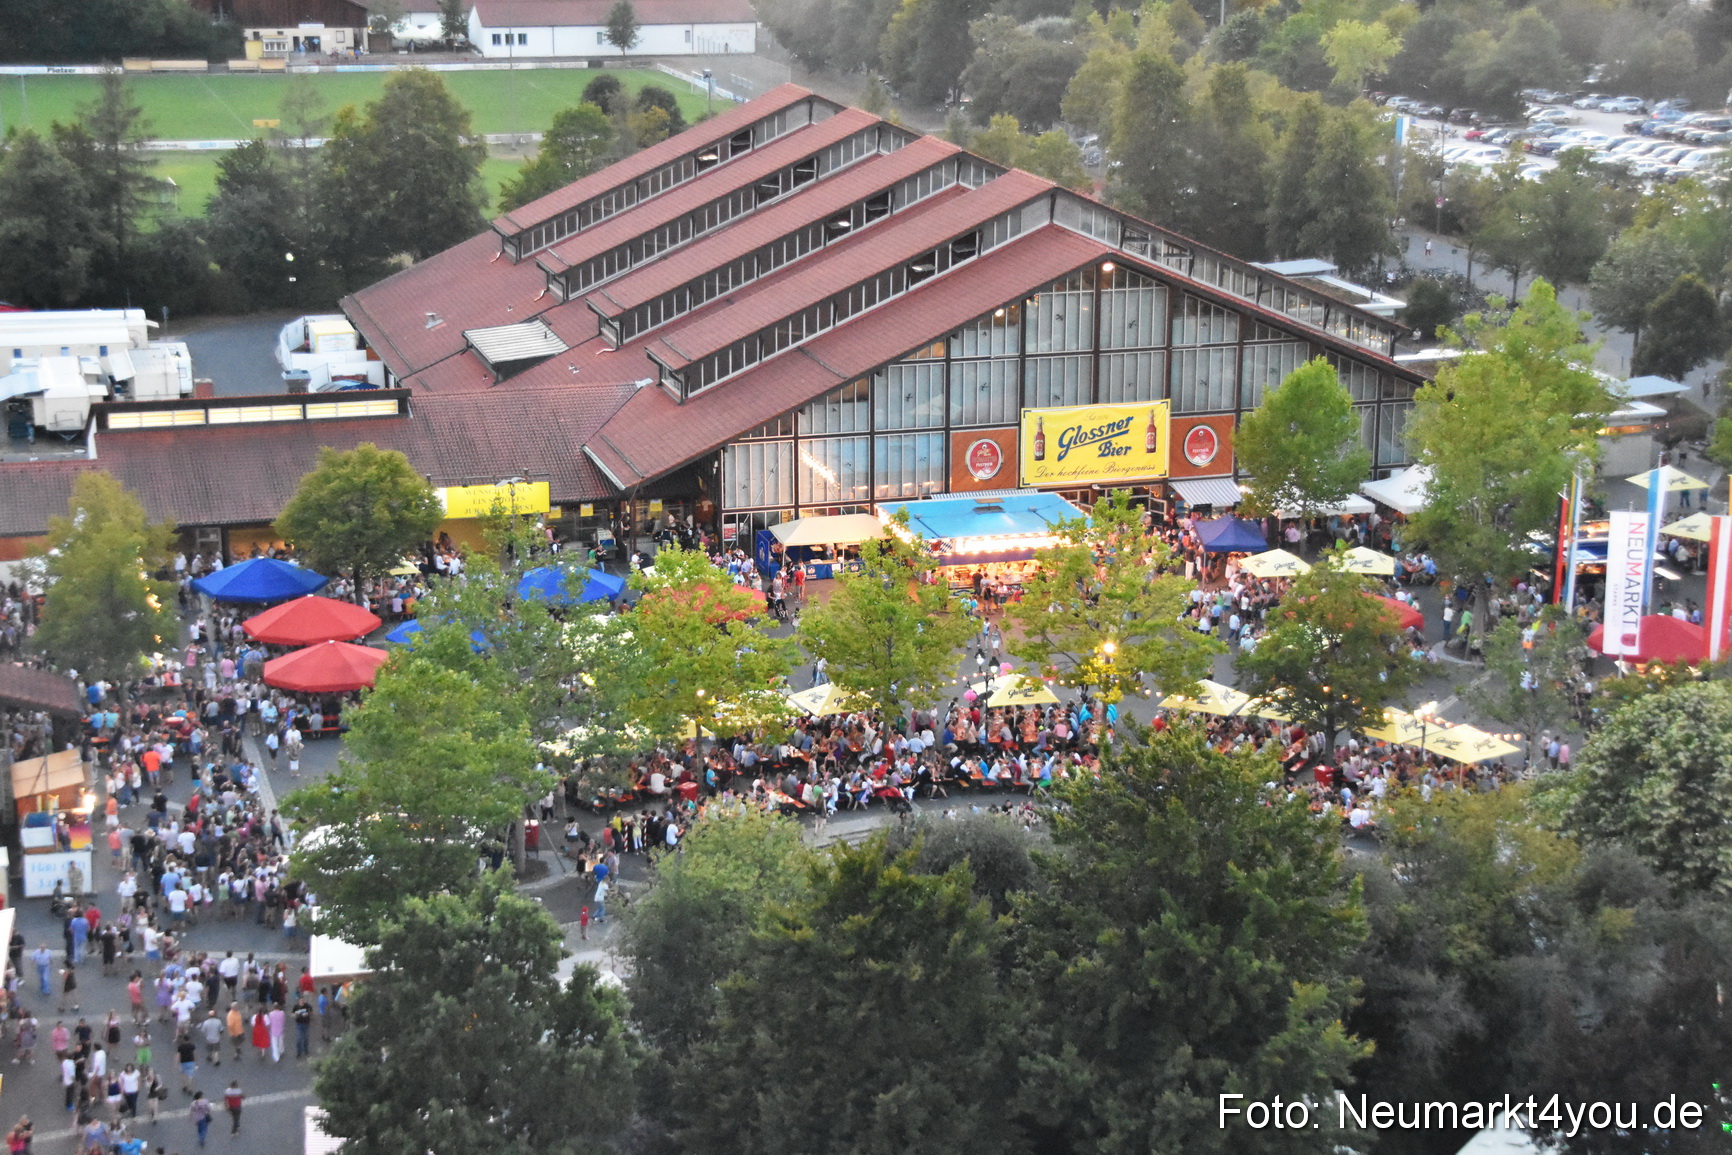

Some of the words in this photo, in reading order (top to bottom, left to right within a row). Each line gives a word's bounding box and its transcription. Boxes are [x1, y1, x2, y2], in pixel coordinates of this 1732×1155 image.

[1057, 416, 1134, 462] Glossner
[1097, 440, 1132, 458] Bier
[1034, 465, 1054, 478] Der
[1057, 464, 1099, 479] hochfeine
[1622, 522, 1645, 628] NEUMARKT
